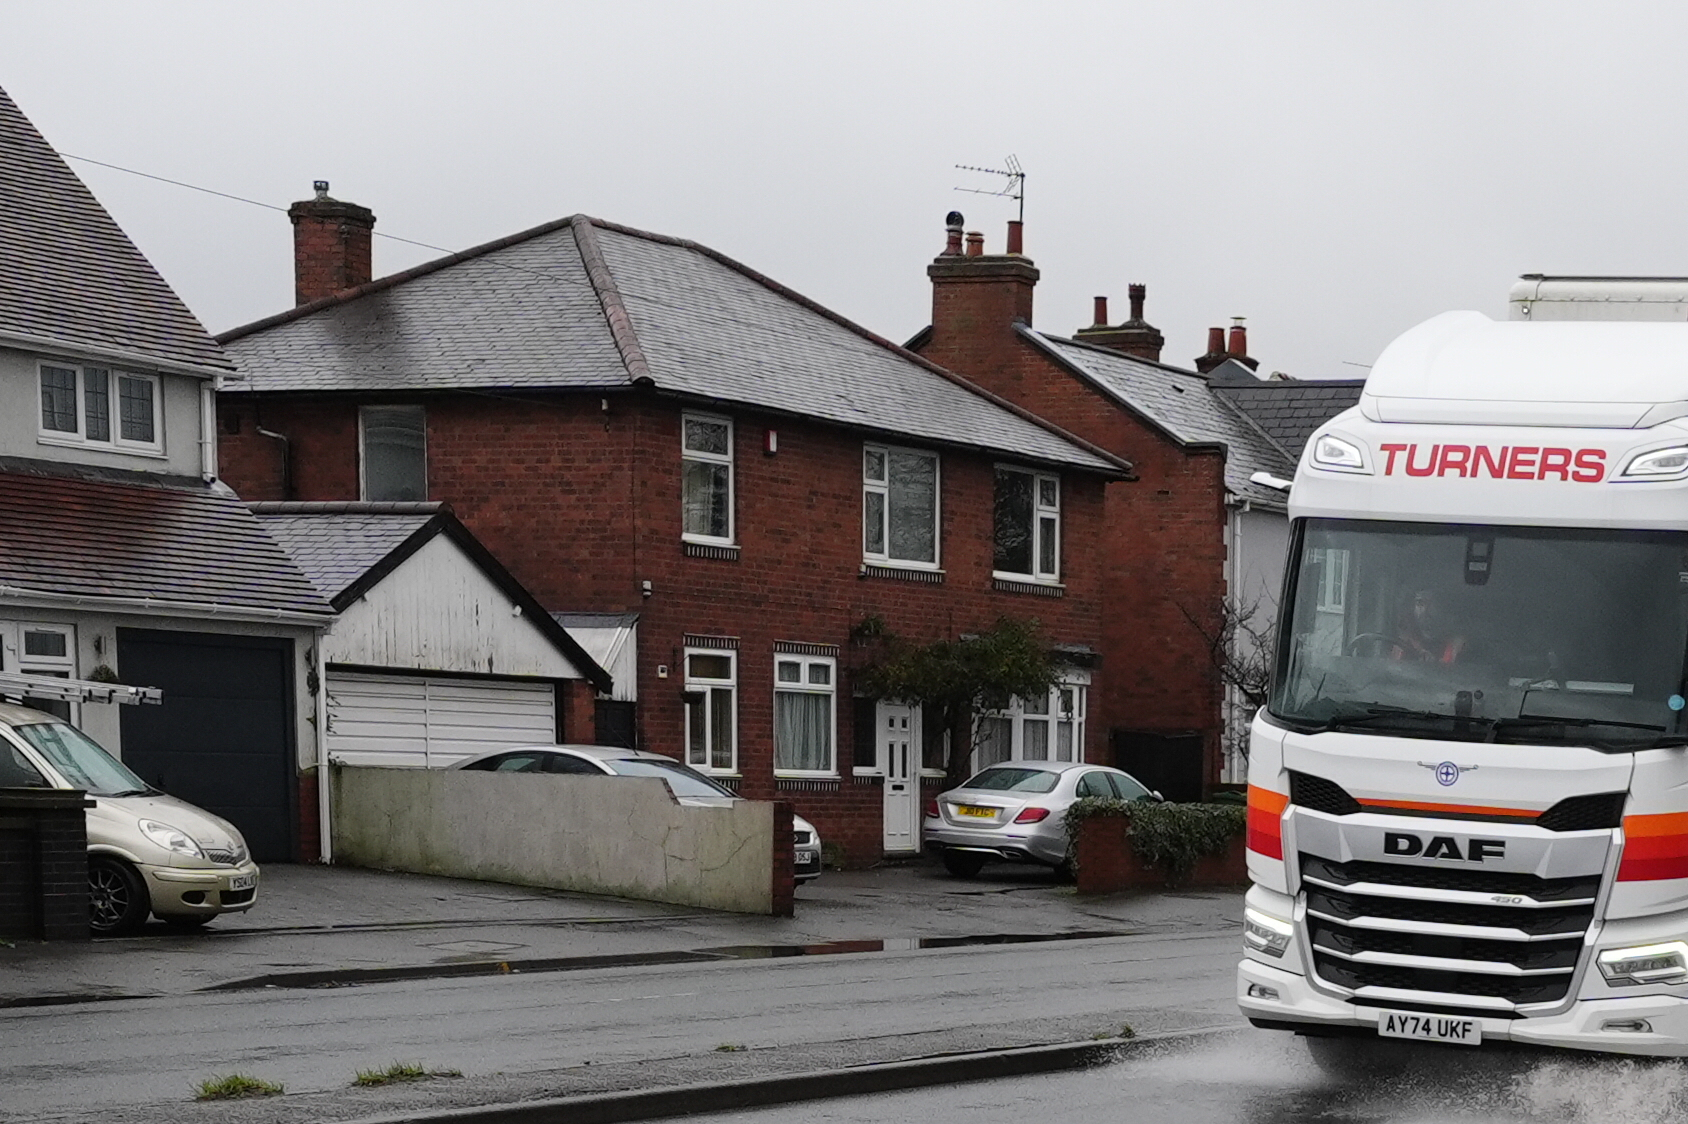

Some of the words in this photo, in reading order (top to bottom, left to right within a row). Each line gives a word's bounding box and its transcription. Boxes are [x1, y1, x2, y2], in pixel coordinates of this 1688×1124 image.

[1379, 443, 1607, 484] TURNERS
[1384, 832, 1506, 863] DAF
[1386, 1015, 1432, 1036] AY74
[1438, 1019, 1473, 1039] UKF
